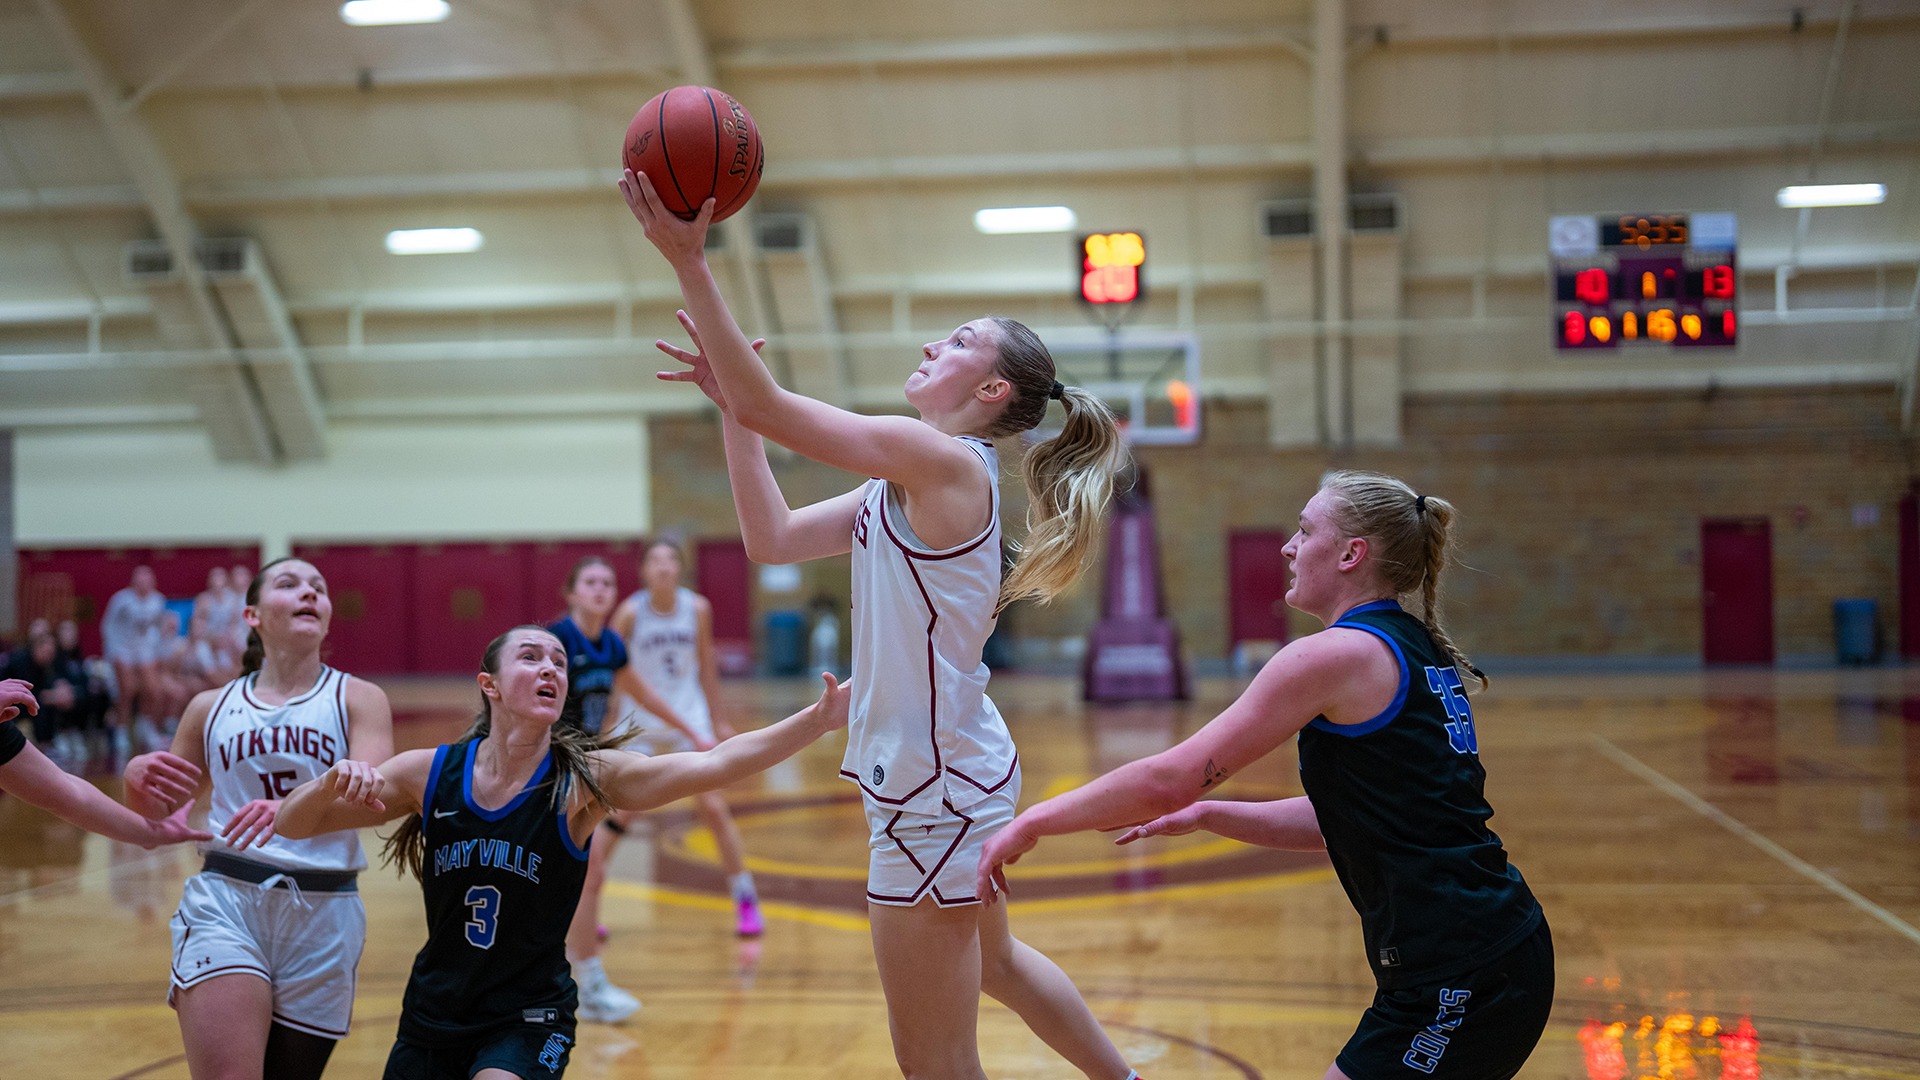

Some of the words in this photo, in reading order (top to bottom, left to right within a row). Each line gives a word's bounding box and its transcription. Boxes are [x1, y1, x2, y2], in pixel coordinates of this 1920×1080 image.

[1424, 666, 1478, 754] 35
[218, 724, 336, 772] VIKINGS
[434, 838, 542, 884] MAYVILLE
[464, 885, 501, 950] 3
